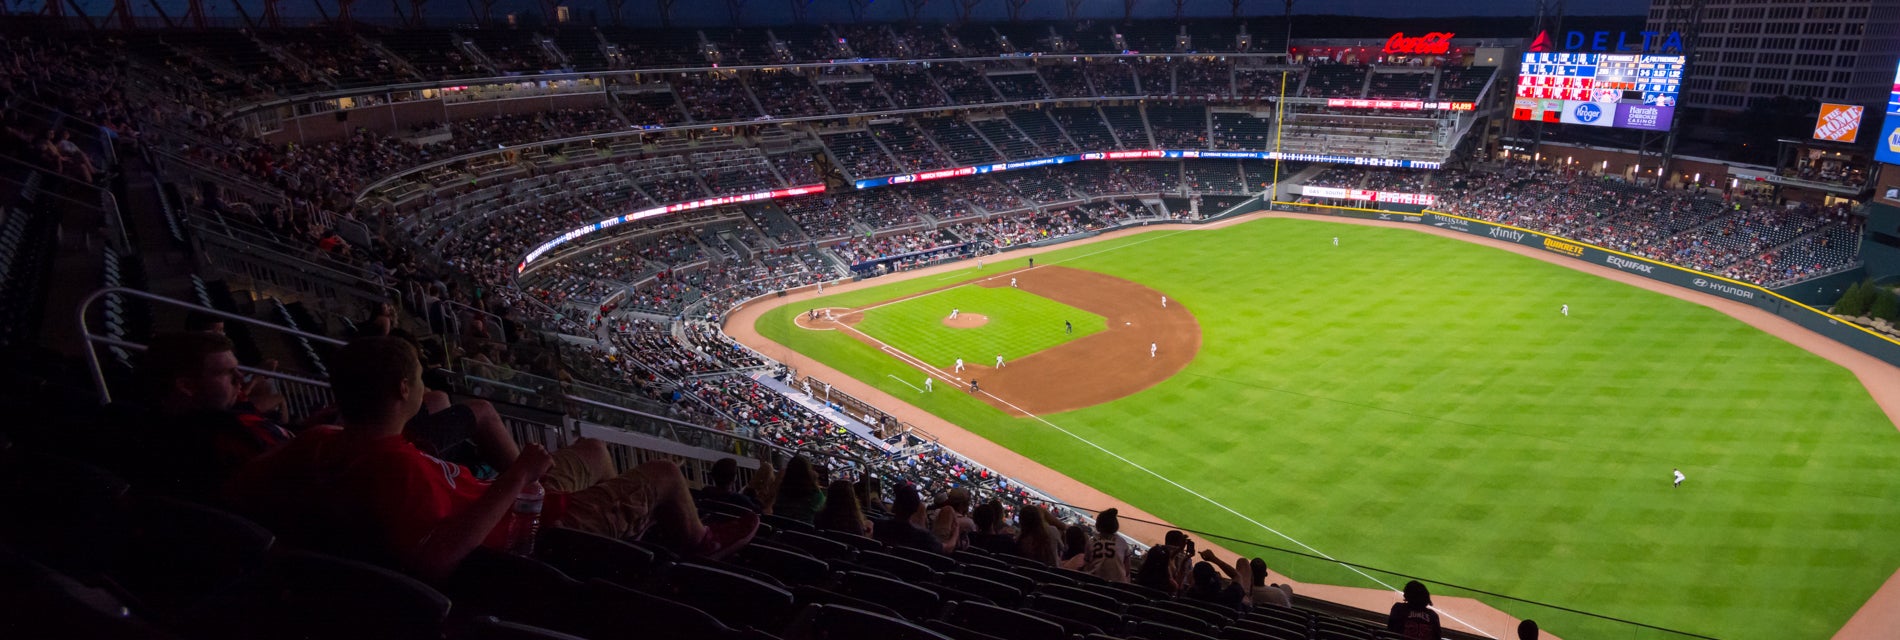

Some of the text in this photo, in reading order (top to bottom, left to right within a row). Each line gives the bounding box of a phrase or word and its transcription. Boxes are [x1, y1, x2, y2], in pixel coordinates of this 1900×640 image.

[1565, 31, 1683, 51] DELTA
[1577, 102, 1600, 121] Kroger
[1823, 108, 1841, 122] THE
[1815, 105, 1861, 139] HOME
[1829, 120, 1859, 140] DEPOT
[1434, 214, 1469, 226] WELLSTAR
[1488, 226, 1524, 243] xfinity
[1544, 237, 1584, 254] QUIKRETE
[1606, 255, 1654, 274] EQUIFAX
[1709, 282, 1753, 299] HYUNDAI
[1092, 541, 1116, 558] 25
